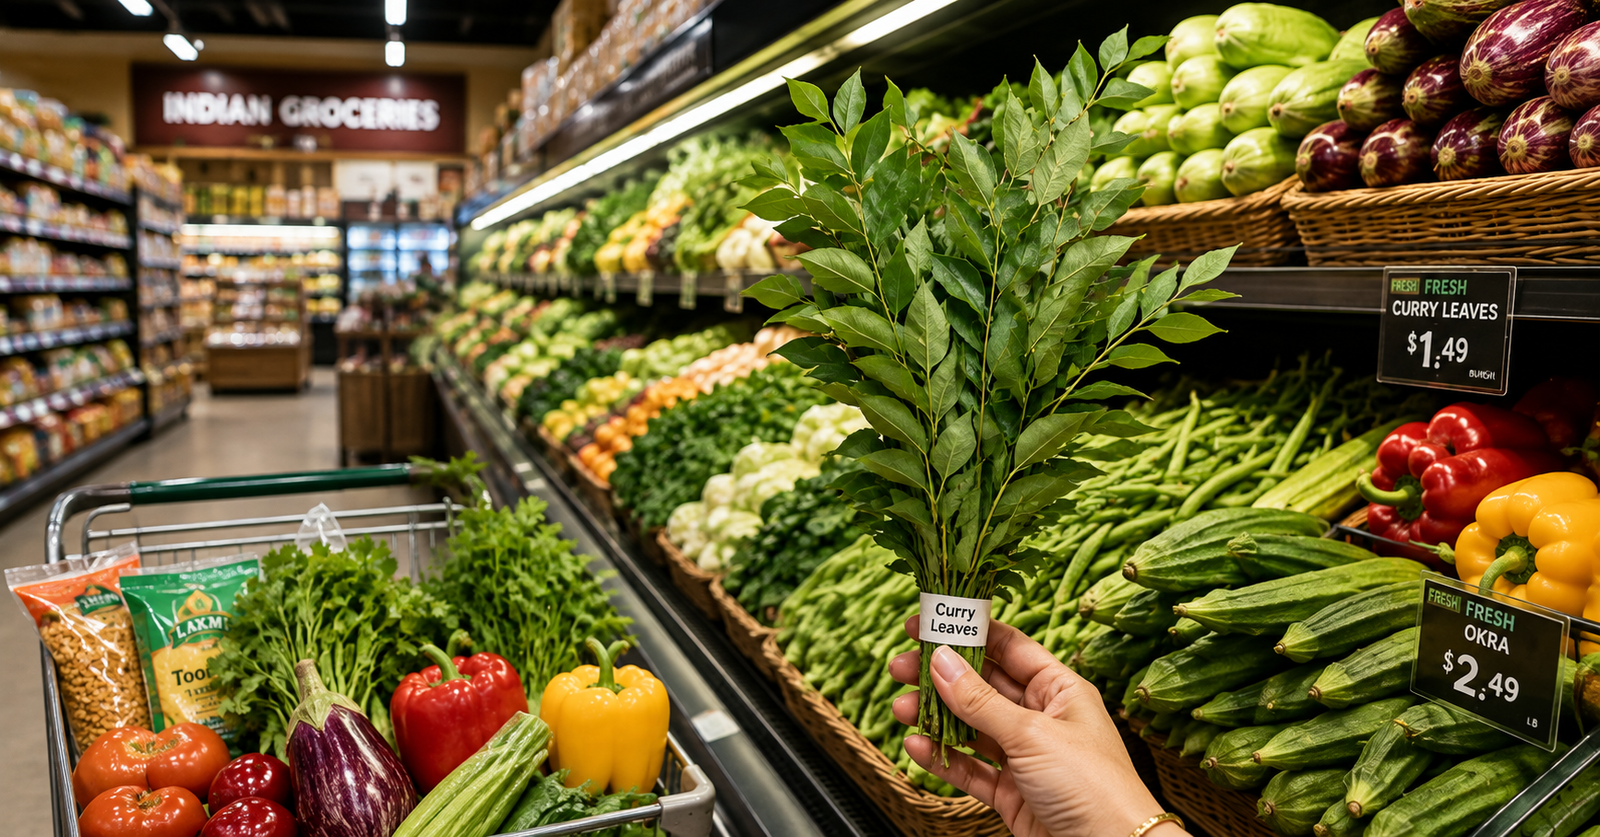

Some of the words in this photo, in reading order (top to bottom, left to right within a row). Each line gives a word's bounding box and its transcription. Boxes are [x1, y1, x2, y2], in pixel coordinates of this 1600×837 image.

[163, 91, 272, 126] INDIAN
[278, 95, 440, 131] GROCERIES
[1391, 280, 1418, 292] FRESH
[1424, 279, 1467, 295] FRESH
[1392, 300, 1439, 317] CURRY
[1442, 301, 1498, 320] LEAVES
[935, 602, 976, 622] Curry
[1428, 587, 1459, 610] FRESH
[1465, 600, 1515, 632] FRESH
[930, 618, 978, 636] Leaves
[1464, 624, 1510, 655] OKRA
[1526, 717, 1538, 728] LB
